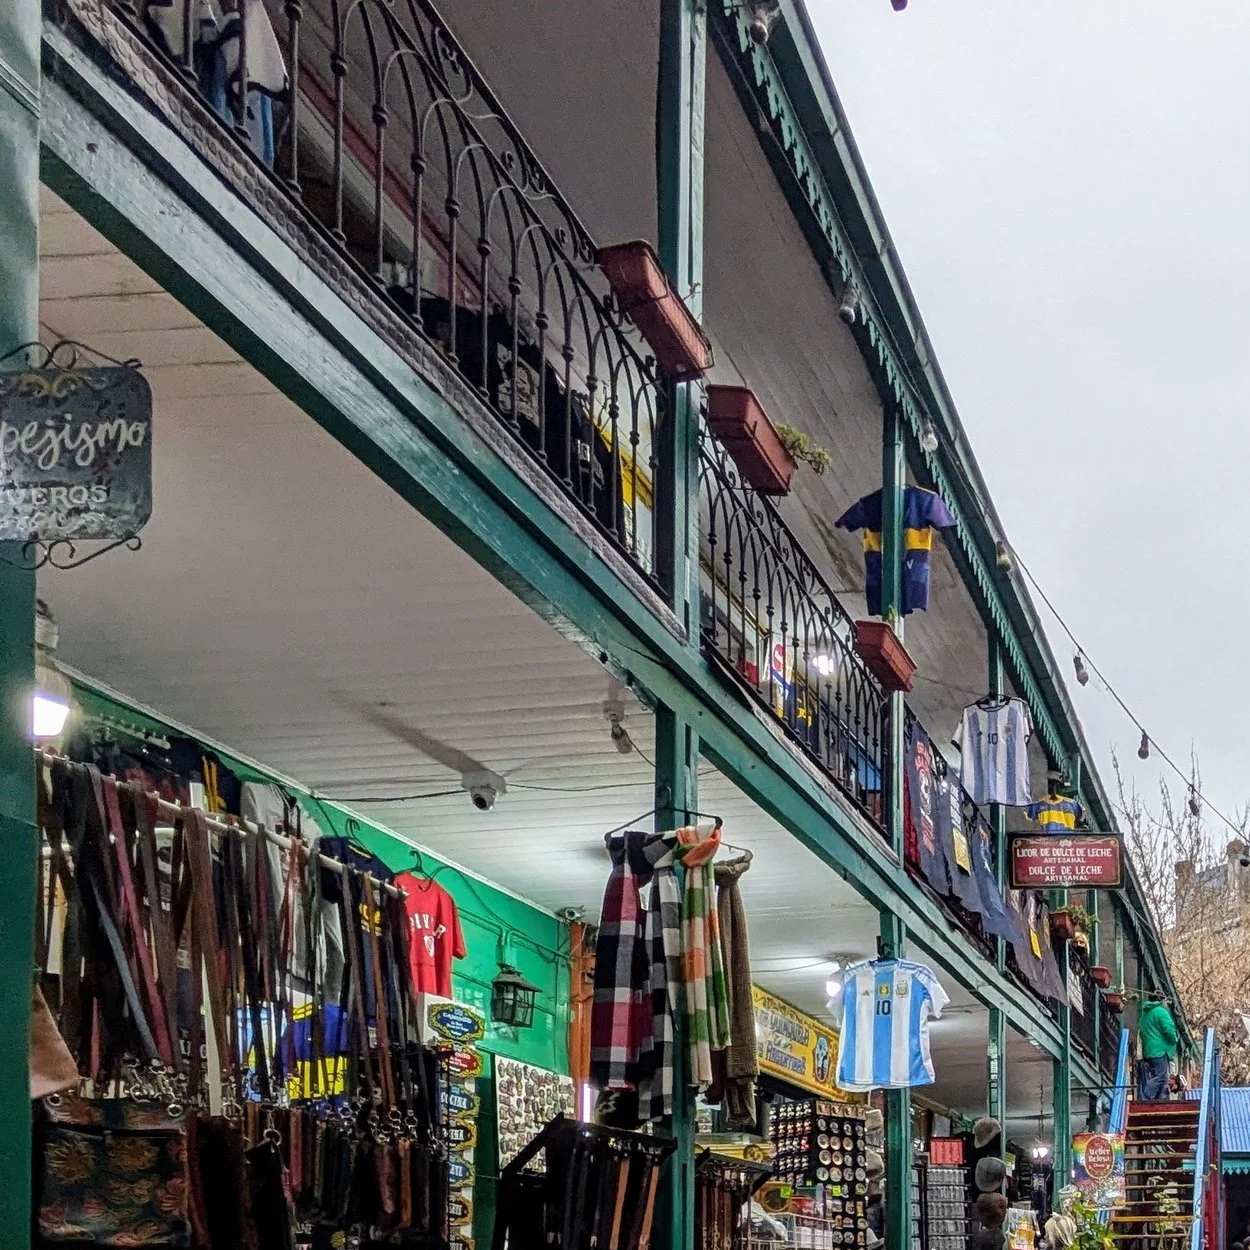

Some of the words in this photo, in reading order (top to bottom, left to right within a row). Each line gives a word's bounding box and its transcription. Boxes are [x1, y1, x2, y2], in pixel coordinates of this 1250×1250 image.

[987, 732, 999, 745] 10
[1016, 848, 1039, 857] LICOR
[1040, 848, 1051, 857] DE
[1052, 848, 1075, 857] DULCE
[1076, 848, 1086, 857] DE
[1087, 848, 1113, 857] LECHE
[1028, 866, 1056, 875] DULCE
[1061, 866, 1072, 874] DE
[1075, 866, 1103, 874] LECHE
[410, 913, 447, 939] IVR
[876, 999, 892, 1016] 10
